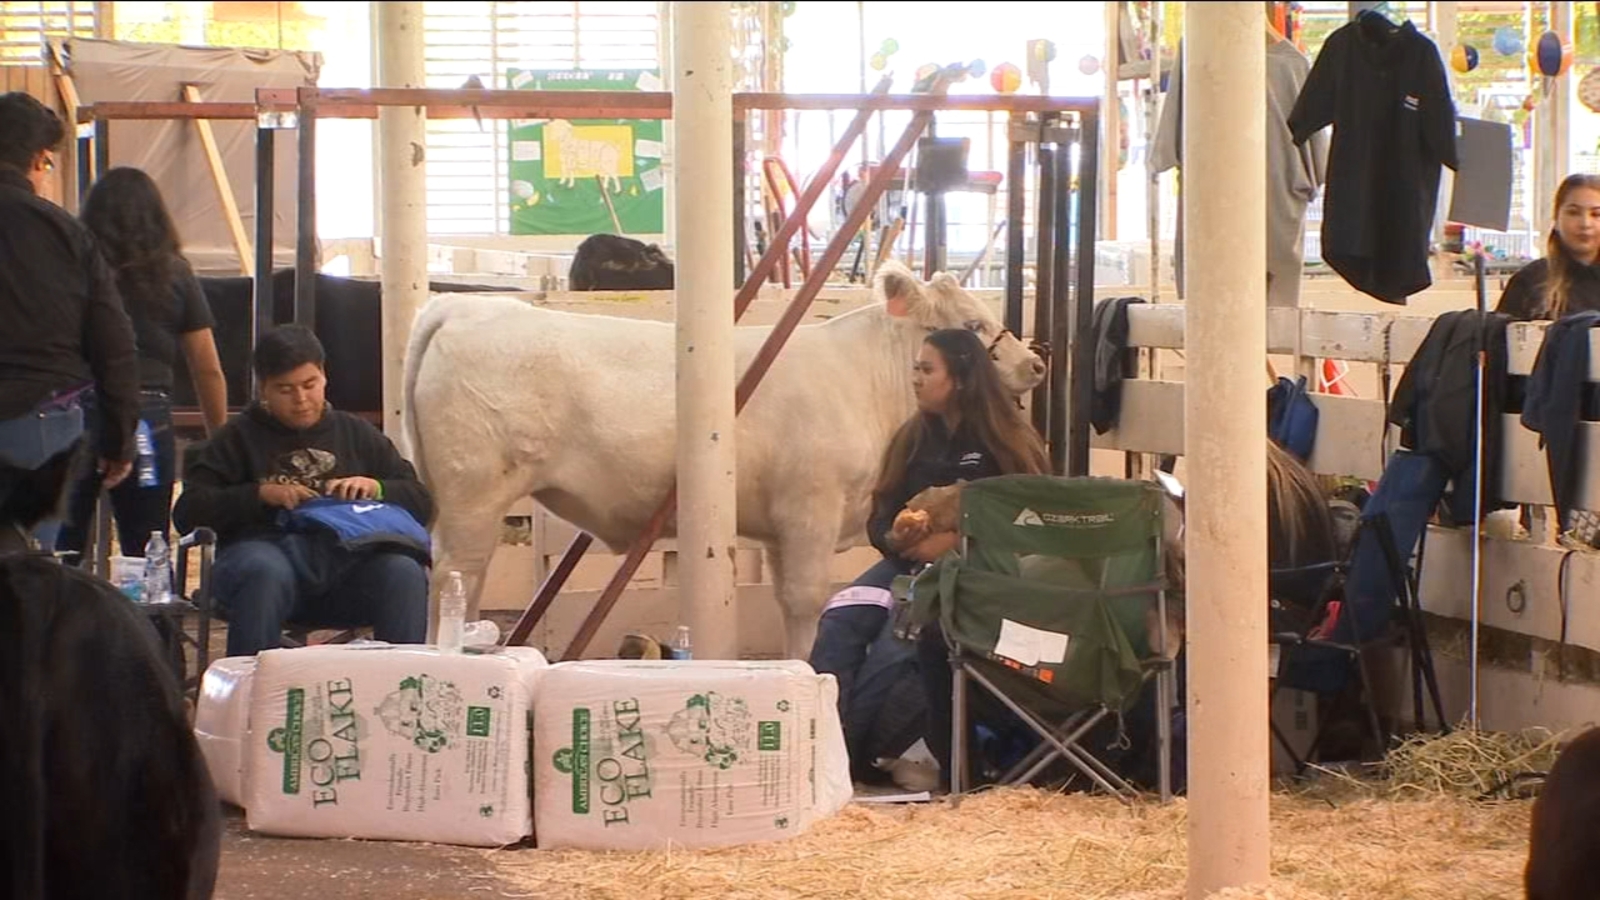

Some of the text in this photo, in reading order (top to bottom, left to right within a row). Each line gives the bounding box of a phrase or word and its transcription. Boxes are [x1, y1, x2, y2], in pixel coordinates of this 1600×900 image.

[327, 678, 361, 780] FLAKE
[613, 697, 652, 801] FLAKE
[308, 738, 338, 808] ECO
[596, 758, 630, 828] ECO
